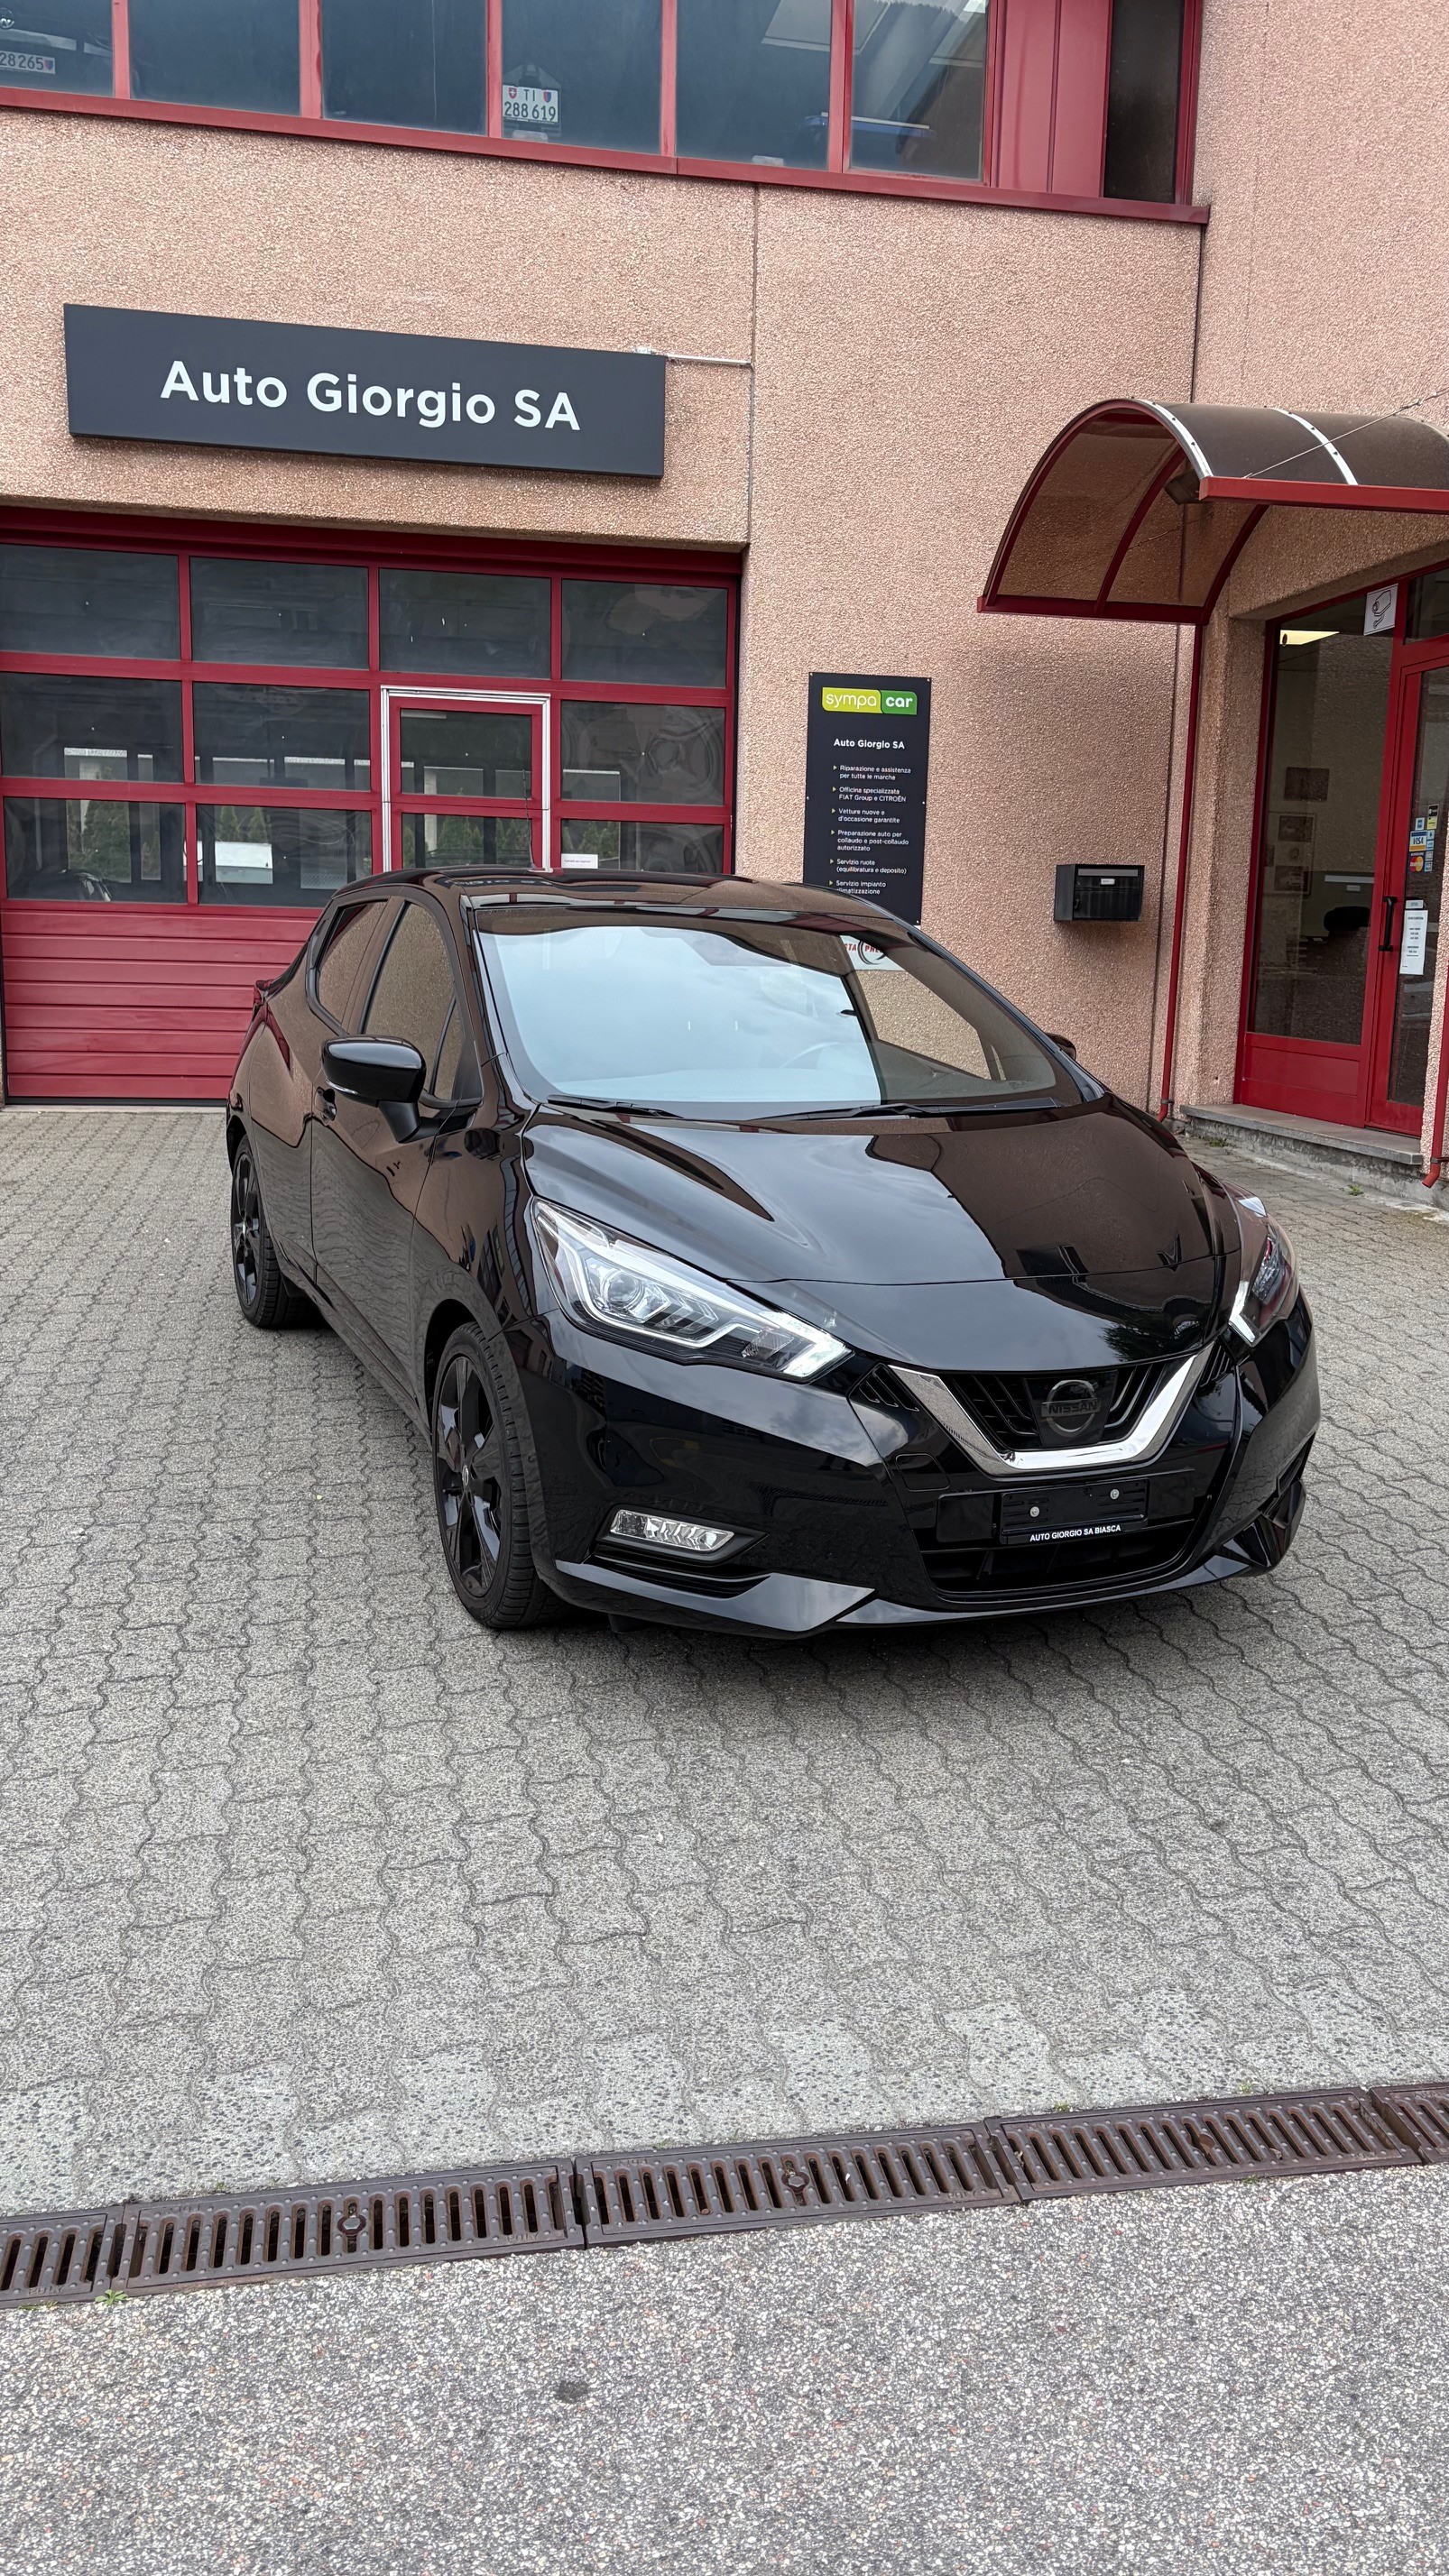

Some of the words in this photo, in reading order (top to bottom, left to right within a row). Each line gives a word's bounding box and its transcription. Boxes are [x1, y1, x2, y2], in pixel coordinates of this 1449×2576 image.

[524, 89, 535, 101] TI
[160, 361, 287, 408] Auto
[307, 373, 495, 428] Giorgio
[513, 389, 581, 430] SA
[826, 694, 876, 709] sympa
[885, 696, 913, 707] car
[833, 738, 855, 748] Auto
[857, 740, 891, 750] Giorgio
[892, 741, 905, 750] SA
[839, 765, 874, 773] Riparazione
[1413, 837, 1424, 845] VISA
[1048, 1401, 1097, 1414] NISSAN
[1029, 1533, 1050, 1542] AUTO
[1051, 1530, 1082, 1540] GIORGIO
[1094, 1524, 1121, 1534] BIASCA
